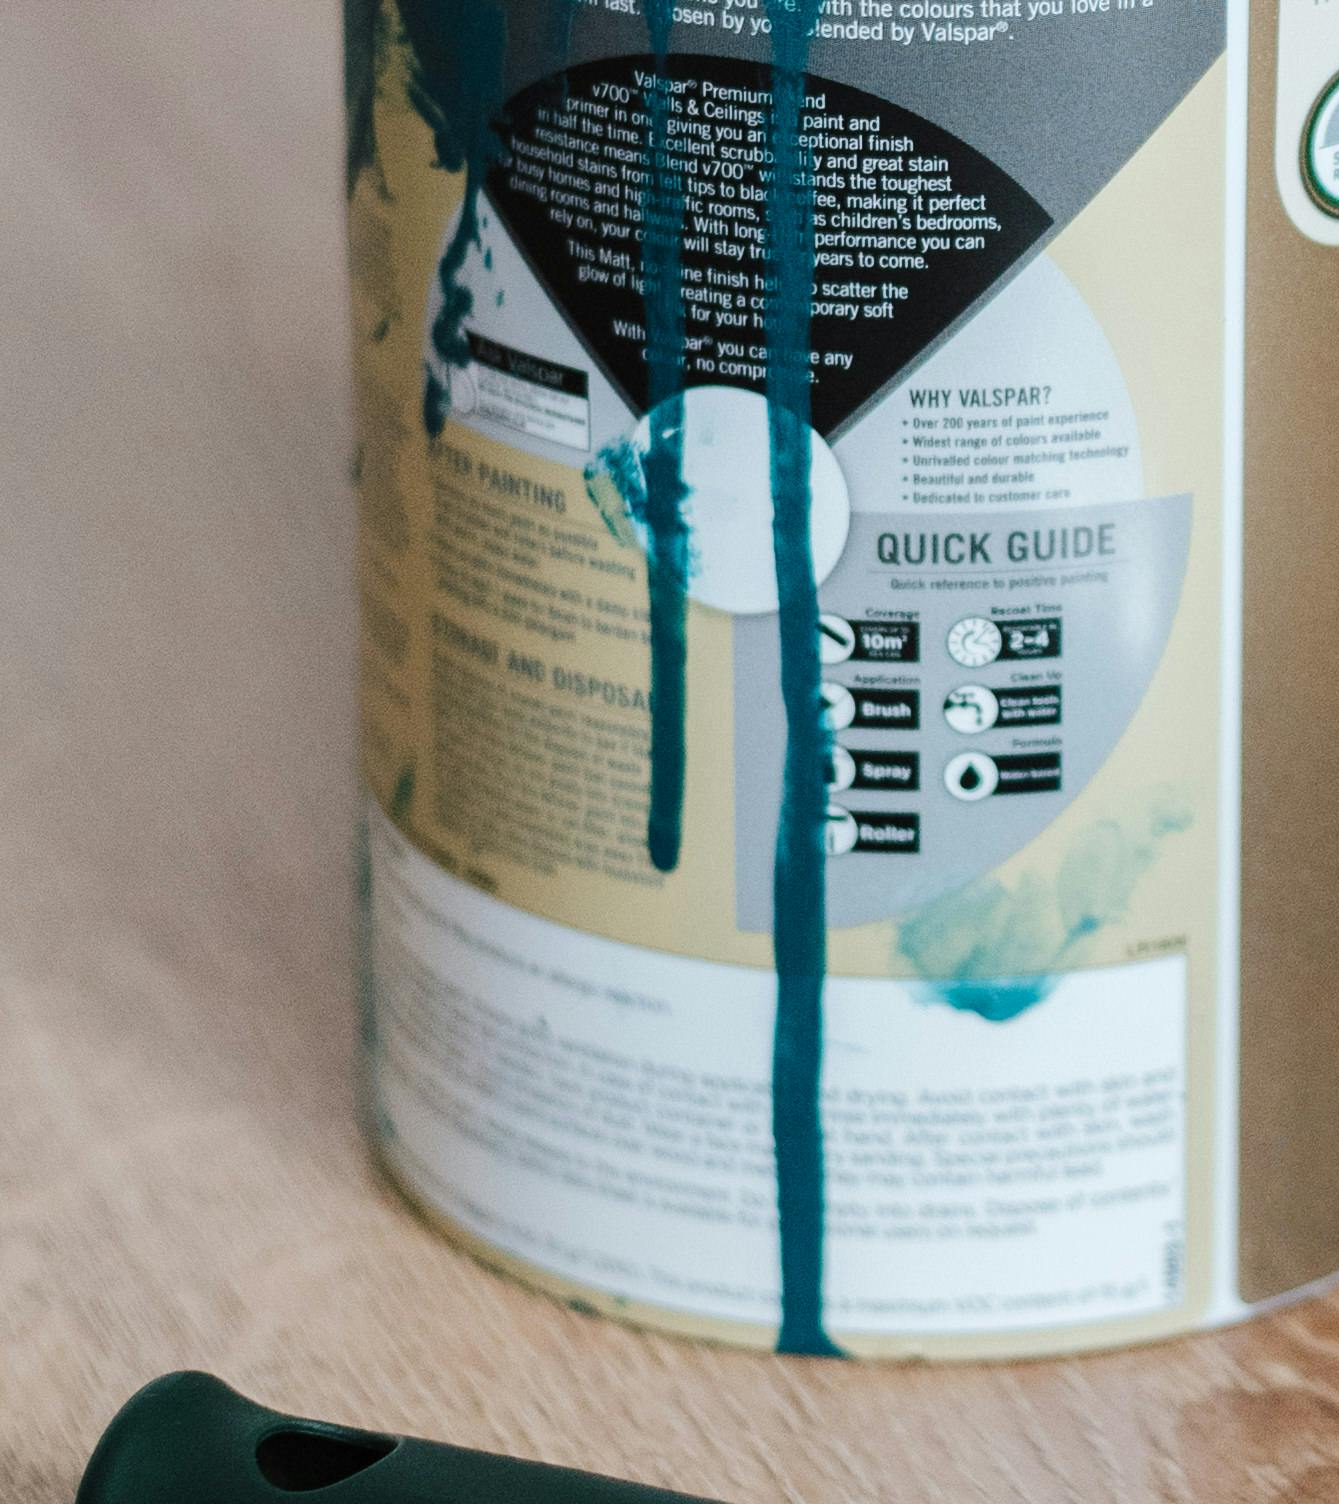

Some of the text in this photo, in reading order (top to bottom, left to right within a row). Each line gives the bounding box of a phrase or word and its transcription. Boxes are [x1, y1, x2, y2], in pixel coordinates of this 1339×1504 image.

[1027, 0, 1064, 21] you
[722, 5, 744, 35] by
[891, 21, 913, 44] by
[702, 81, 773, 105] Premium
[565, 98, 914, 153] primer in giving you an finish
[687, 98, 700, 115] &
[704, 100, 766, 127] Ceilings
[803, 111, 844, 132] paint
[849, 116, 880, 132] and
[553, 110, 577, 131] half
[582, 116, 603, 136] the
[608, 122, 642, 145] time.
[827, 154, 858, 170] and
[862, 153, 903, 173] great
[909, 153, 949, 172] stain
[534, 126, 600, 154] resistance
[604, 145, 650, 166] means
[850, 175, 876, 191] the
[881, 175, 952, 194] toughest
[511, 135, 574, 168] household
[577, 155, 618, 180] stains
[622, 165, 654, 186] from
[687, 176, 716, 197] tips
[720, 180, 734, 198] to
[847, 193, 908, 214] making
[912, 193, 923, 210] it
[929, 193, 986, 215] perfect
[549, 165, 591, 192] homes
[594, 179, 620, 199] and
[708, 202, 760, 223] rooms,
[831, 210, 911, 231] children's
[917, 213, 1002, 232] bedrooms,
[551, 189, 591, 211] rooms
[594, 199, 620, 218] and
[693, 215, 729, 238] With
[815, 231, 917, 250] performance
[921, 234, 950, 254] you
[955, 235, 985, 249] can
[551, 206, 575, 230] rely
[577, 213, 598, 234] on,
[601, 217, 631, 239] your
[684, 236, 710, 253] will
[714, 241, 745, 262] stay
[813, 252, 853, 269] years
[858, 252, 875, 267] to
[879, 256, 929, 269] come.
[568, 240, 908, 300] This Matt, finish scatter the
[579, 266, 610, 286] glow
[613, 271, 626, 289] of
[737, 294, 746, 308] a
[864, 301, 894, 319] soft
[690, 304, 748, 331] for your
[613, 319, 853, 370] With you any
[696, 356, 715, 373] no
[909, 386, 1052, 409] WHY VALSPAR?
[913, 409, 1110, 431] Over 200 years of paint experience
[913, 428, 1101, 450] Widest range of colours available
[913, 444, 1129, 467] Unrivalled colour matching technology
[913, 471, 1034, 486] Beautiful and durable
[913, 492, 970, 504] Dedicated
[974, 492, 985, 503] to
[988, 489, 1041, 503] customer
[877, 523, 1116, 566] QUICK GUIDE
[890, 578, 926, 591] Quick
[930, 577, 989, 590] reference
[993, 577, 1005, 589] to
[1009, 574, 1056, 590] positive
[1010, 631, 1050, 649] 2-4
[861, 702, 912, 718] Brush
[862, 762, 912, 780] Spray
[860, 826, 915, 842] Roller
